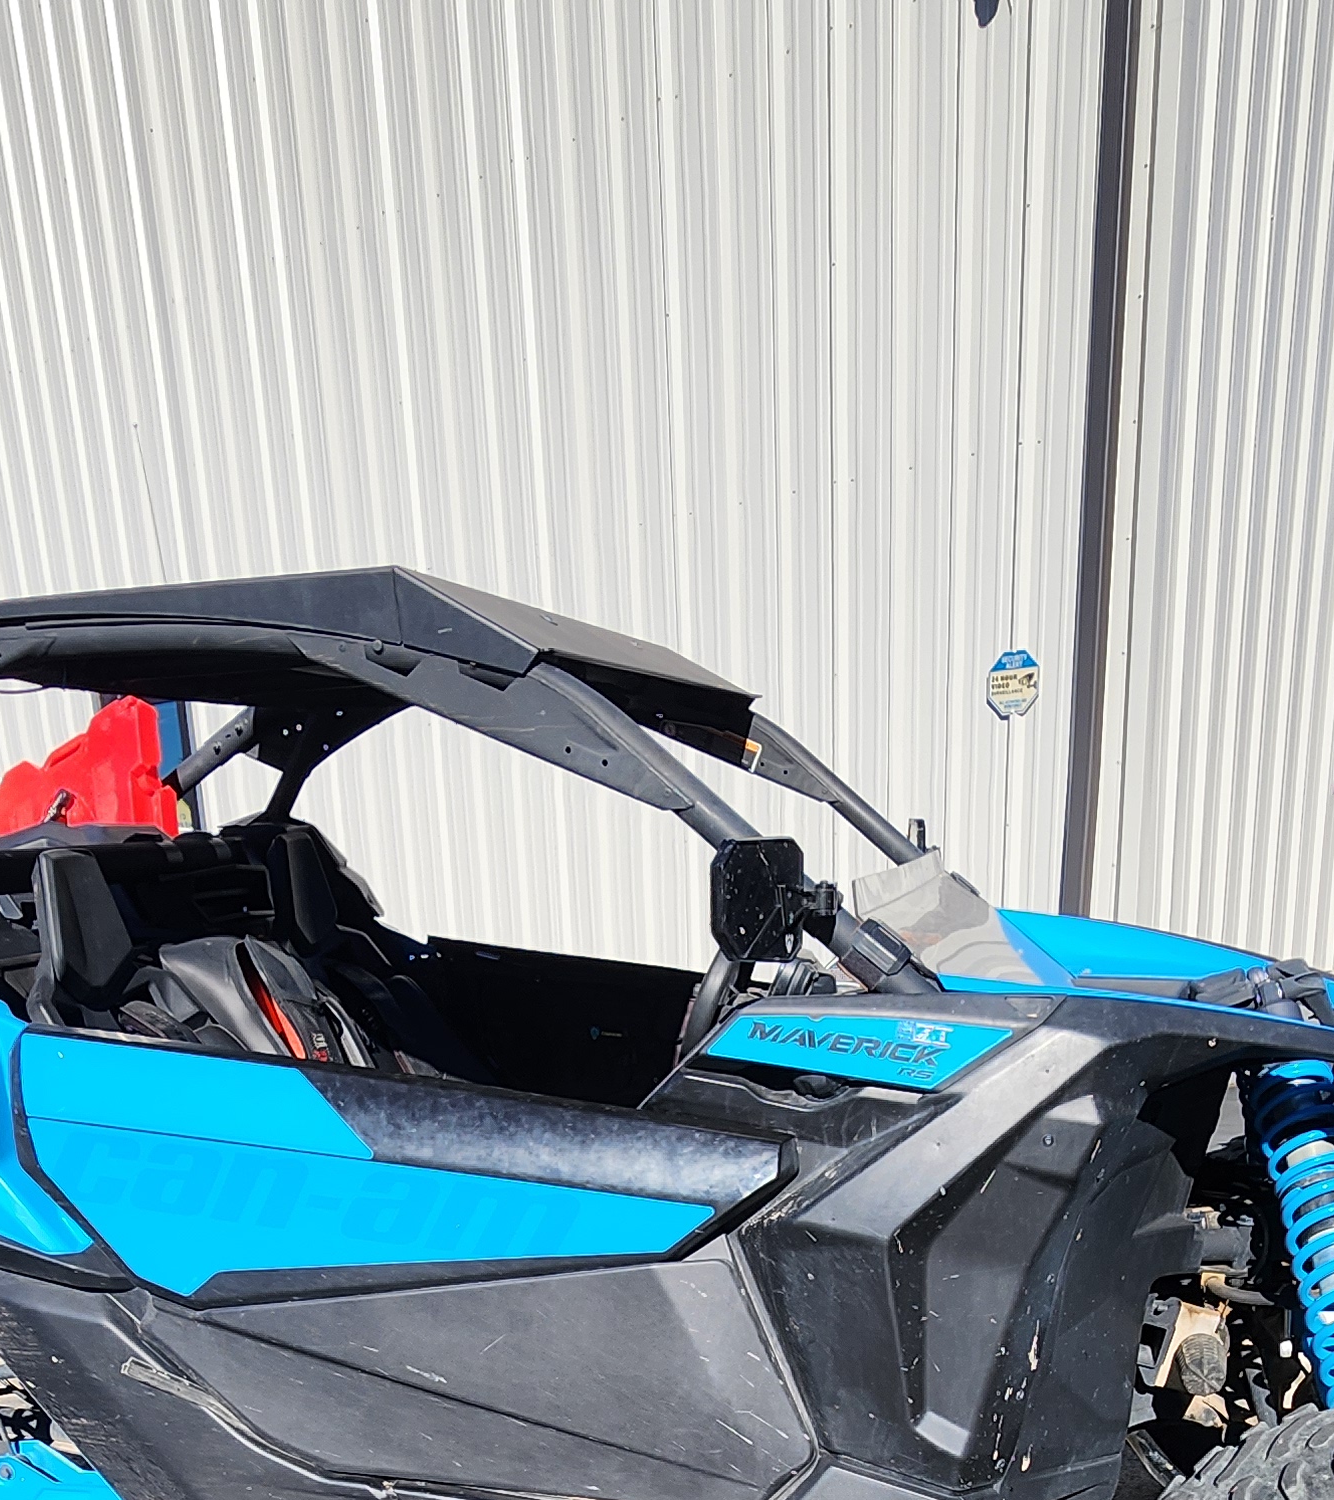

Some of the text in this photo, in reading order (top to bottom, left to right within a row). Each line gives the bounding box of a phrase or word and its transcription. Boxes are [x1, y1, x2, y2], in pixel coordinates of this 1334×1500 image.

[991, 682, 1010, 690] VIDEO
[748, 1020, 945, 1067] MAVERICK
[896, 1066, 936, 1081] RS
[52, 1130, 582, 1255] can-am
